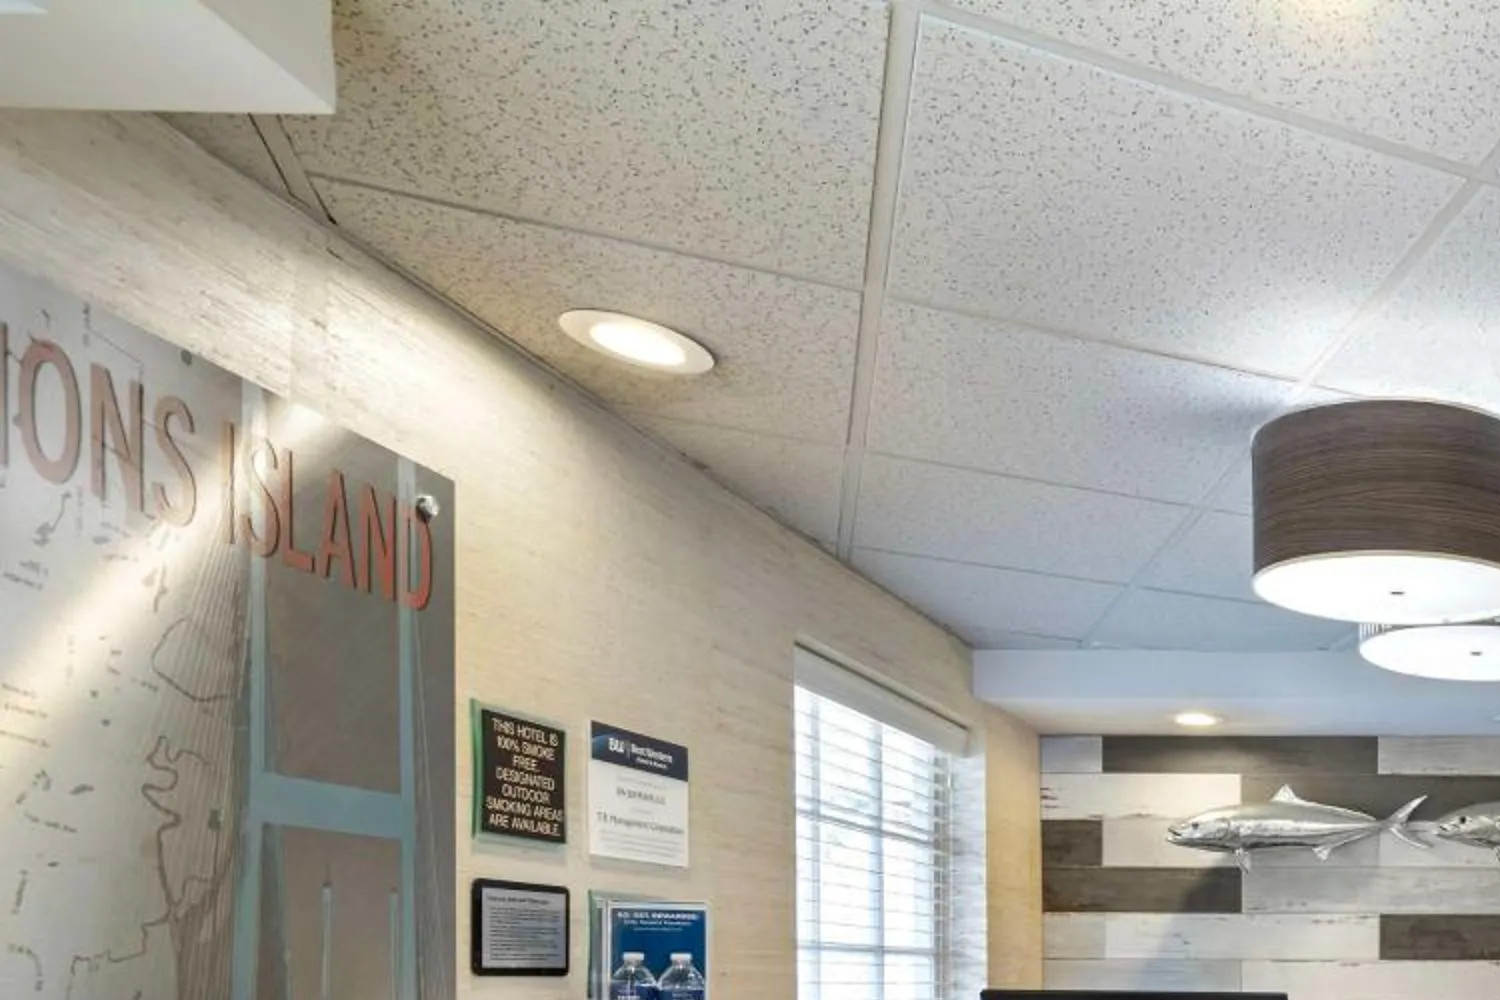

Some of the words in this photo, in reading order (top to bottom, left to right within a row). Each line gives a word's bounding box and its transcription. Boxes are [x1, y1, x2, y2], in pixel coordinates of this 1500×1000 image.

[0, 321, 198, 528] ONS
[222, 421, 433, 611] ISLAND
[492, 718, 515, 736] THIS
[517, 723, 547, 744] HOTEL
[549, 731, 559, 747] IS
[496, 736, 520, 753] 100%
[521, 741, 555, 761] SMOKE
[512, 756, 540, 773] FREE
[495, 768, 555, 792] DESIGNATED
[501, 783, 550, 804] OUTDOOR
[486, 796, 532, 817] SMOKING
[533, 806, 563, 822] AREAS
[489, 813, 509, 828] ARE
[510, 816, 561, 836] AVAILABLE
